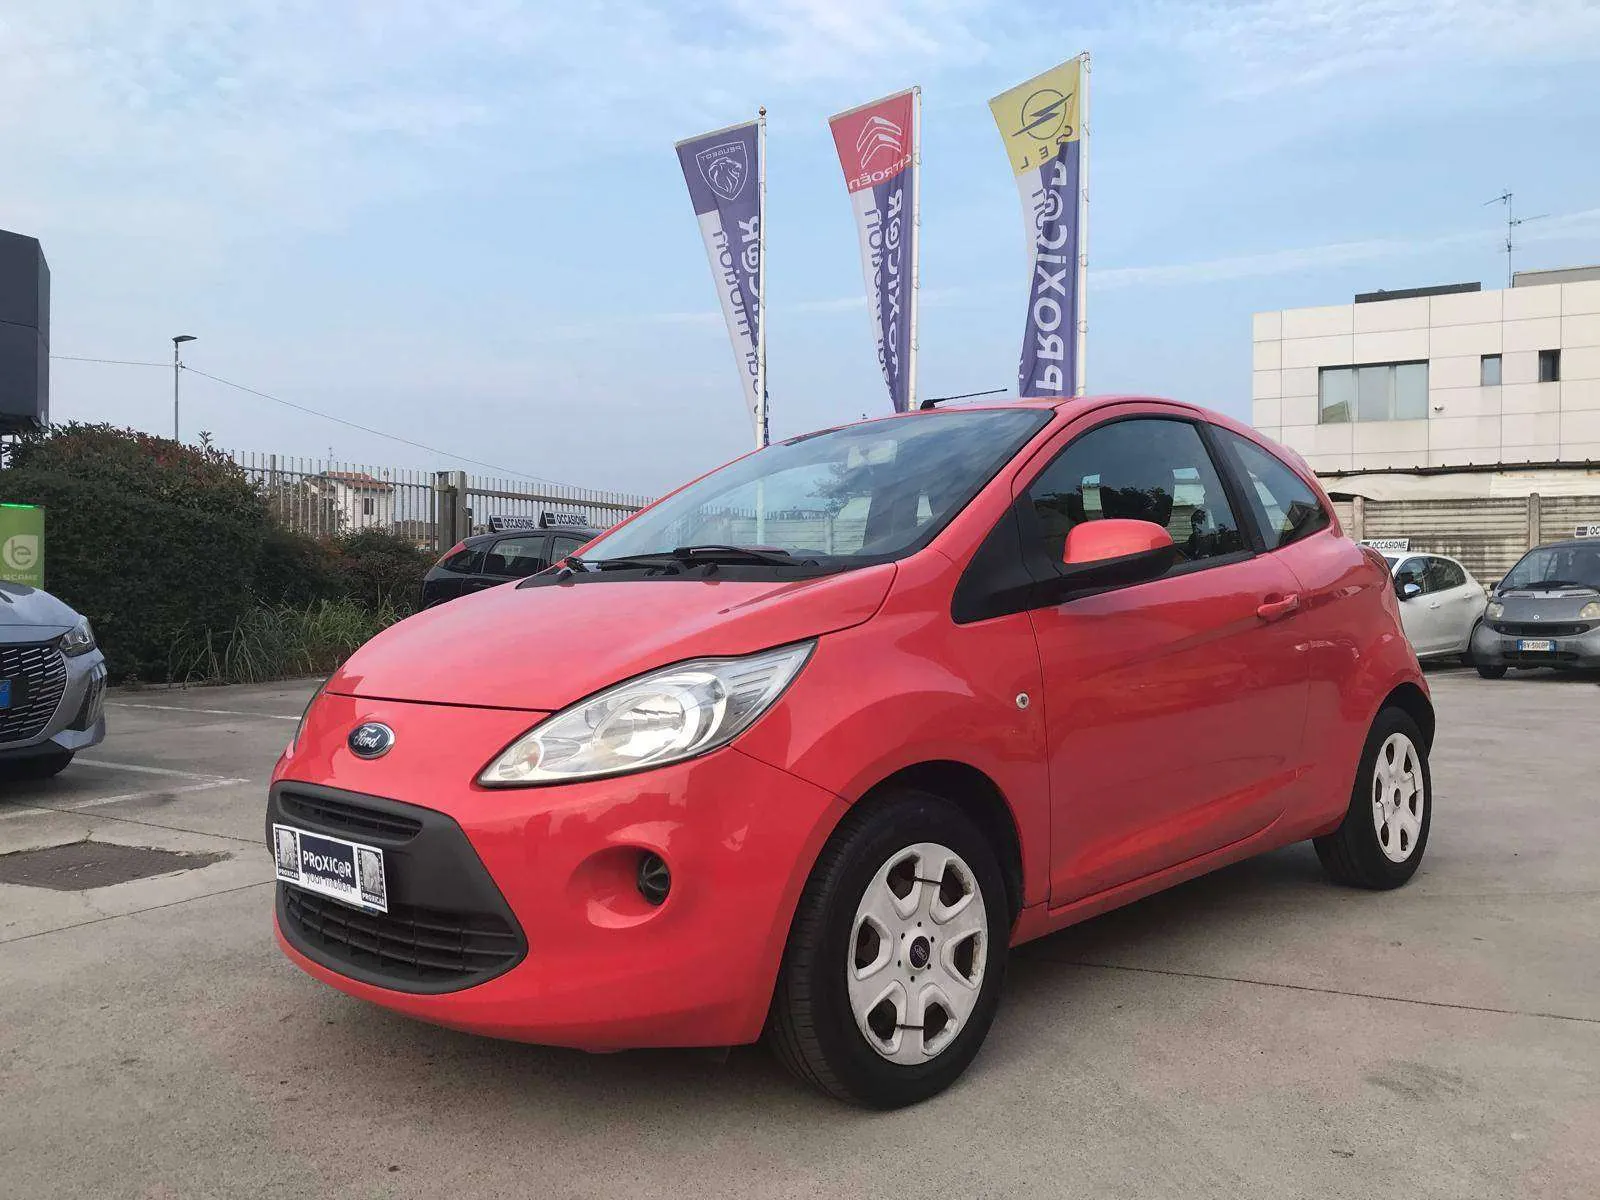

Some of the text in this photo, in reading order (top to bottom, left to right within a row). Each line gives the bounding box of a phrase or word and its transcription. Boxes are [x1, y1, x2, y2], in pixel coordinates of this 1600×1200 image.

[503, 518, 535, 530] OCCASIONE
[556, 513, 588, 526] OCCASIONE
[1371, 541, 1407, 549] OCCASIONE
[353, 727, 381, 748] Ford
